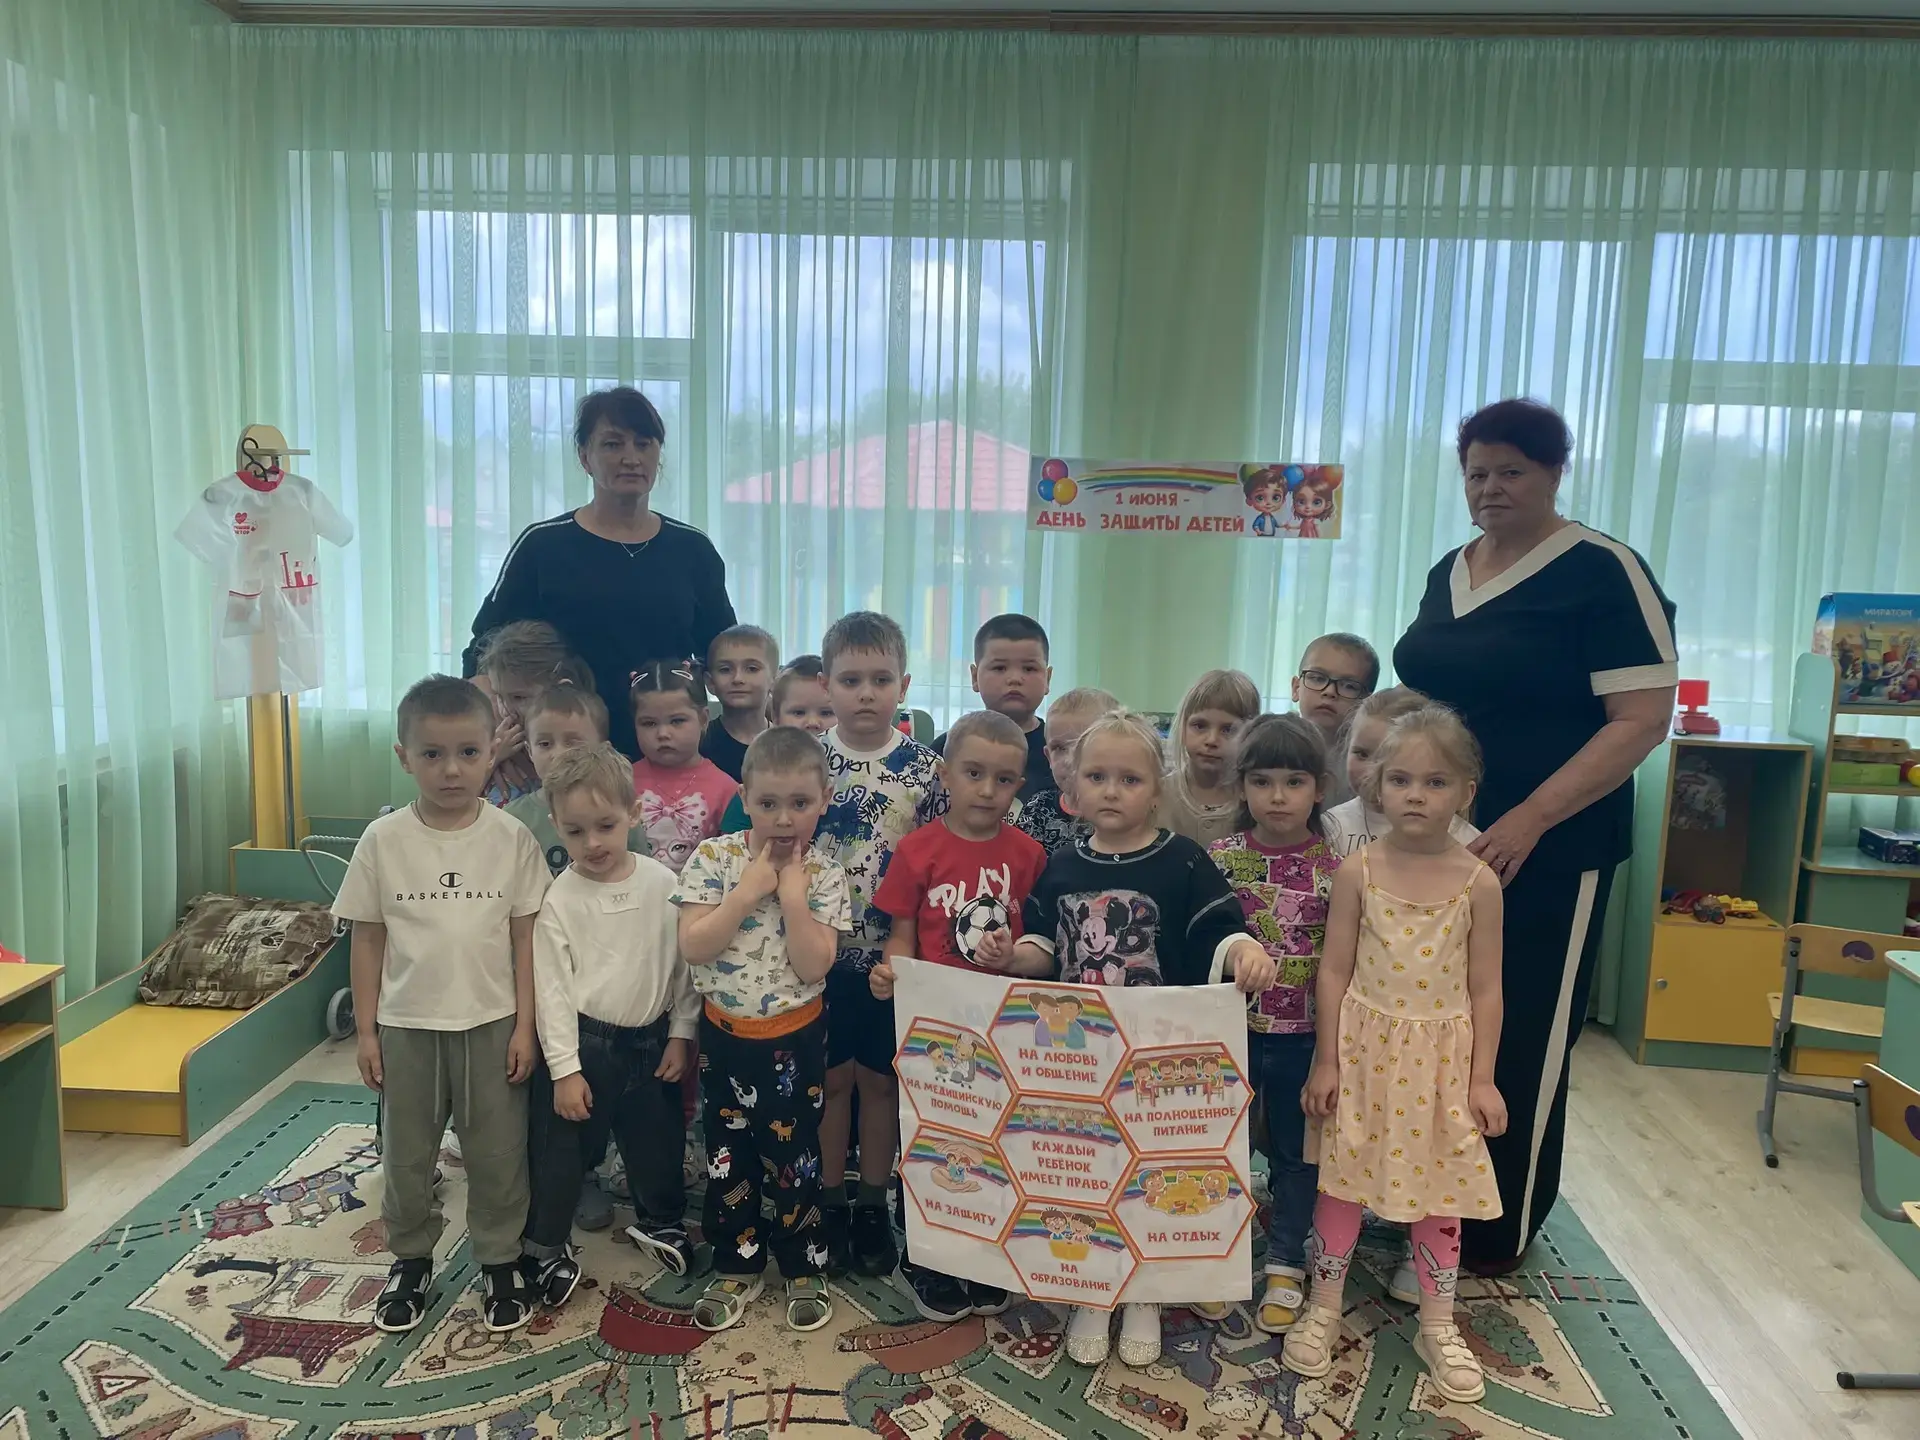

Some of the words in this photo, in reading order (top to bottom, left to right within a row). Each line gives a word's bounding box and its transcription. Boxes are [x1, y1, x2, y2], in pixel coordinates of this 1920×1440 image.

[1115, 493, 1123, 504] 1
[1129, 493, 1178, 506] ИЮНЯ
[1036, 511, 1087, 527] ДЕНЬ
[1100, 514, 1180, 530] ЗАЩИТЫ
[1187, 515, 1244, 532] ДЕТЕЙ
[396, 891, 503, 901] BASKETBALL
[928, 863, 1011, 918] PLAY
[1019, 1048, 1038, 1060] НА
[1044, 1052, 1097, 1066] ЛЮБОВЬ
[1022, 1066, 1031, 1076] И
[1036, 1067, 1097, 1083] ОБЩЕНИЕ
[906, 1078, 921, 1089] НА
[924, 1083, 1002, 1110] МЕДИЦИНСКУЮ
[931, 1098, 977, 1118] ПОМОЩЬ
[1124, 1113, 1142, 1122] НА
[1147, 1107, 1236, 1121] ПОЛНОЦЕННОЕ
[1154, 1124, 1208, 1136] ПИТАНИЕ
[1020, 1171, 1061, 1185] ИМЕЕТ
[925, 1199, 941, 1211] НА
[945, 1204, 996, 1225] ЗАЩИТУ
[1148, 1232, 1167, 1242] НА
[1172, 1231, 1221, 1242] ОТДЫХ
[1061, 1263, 1078, 1273] НА
[1030, 1273, 1111, 1291] ОБРАЗОВАНИЕ
